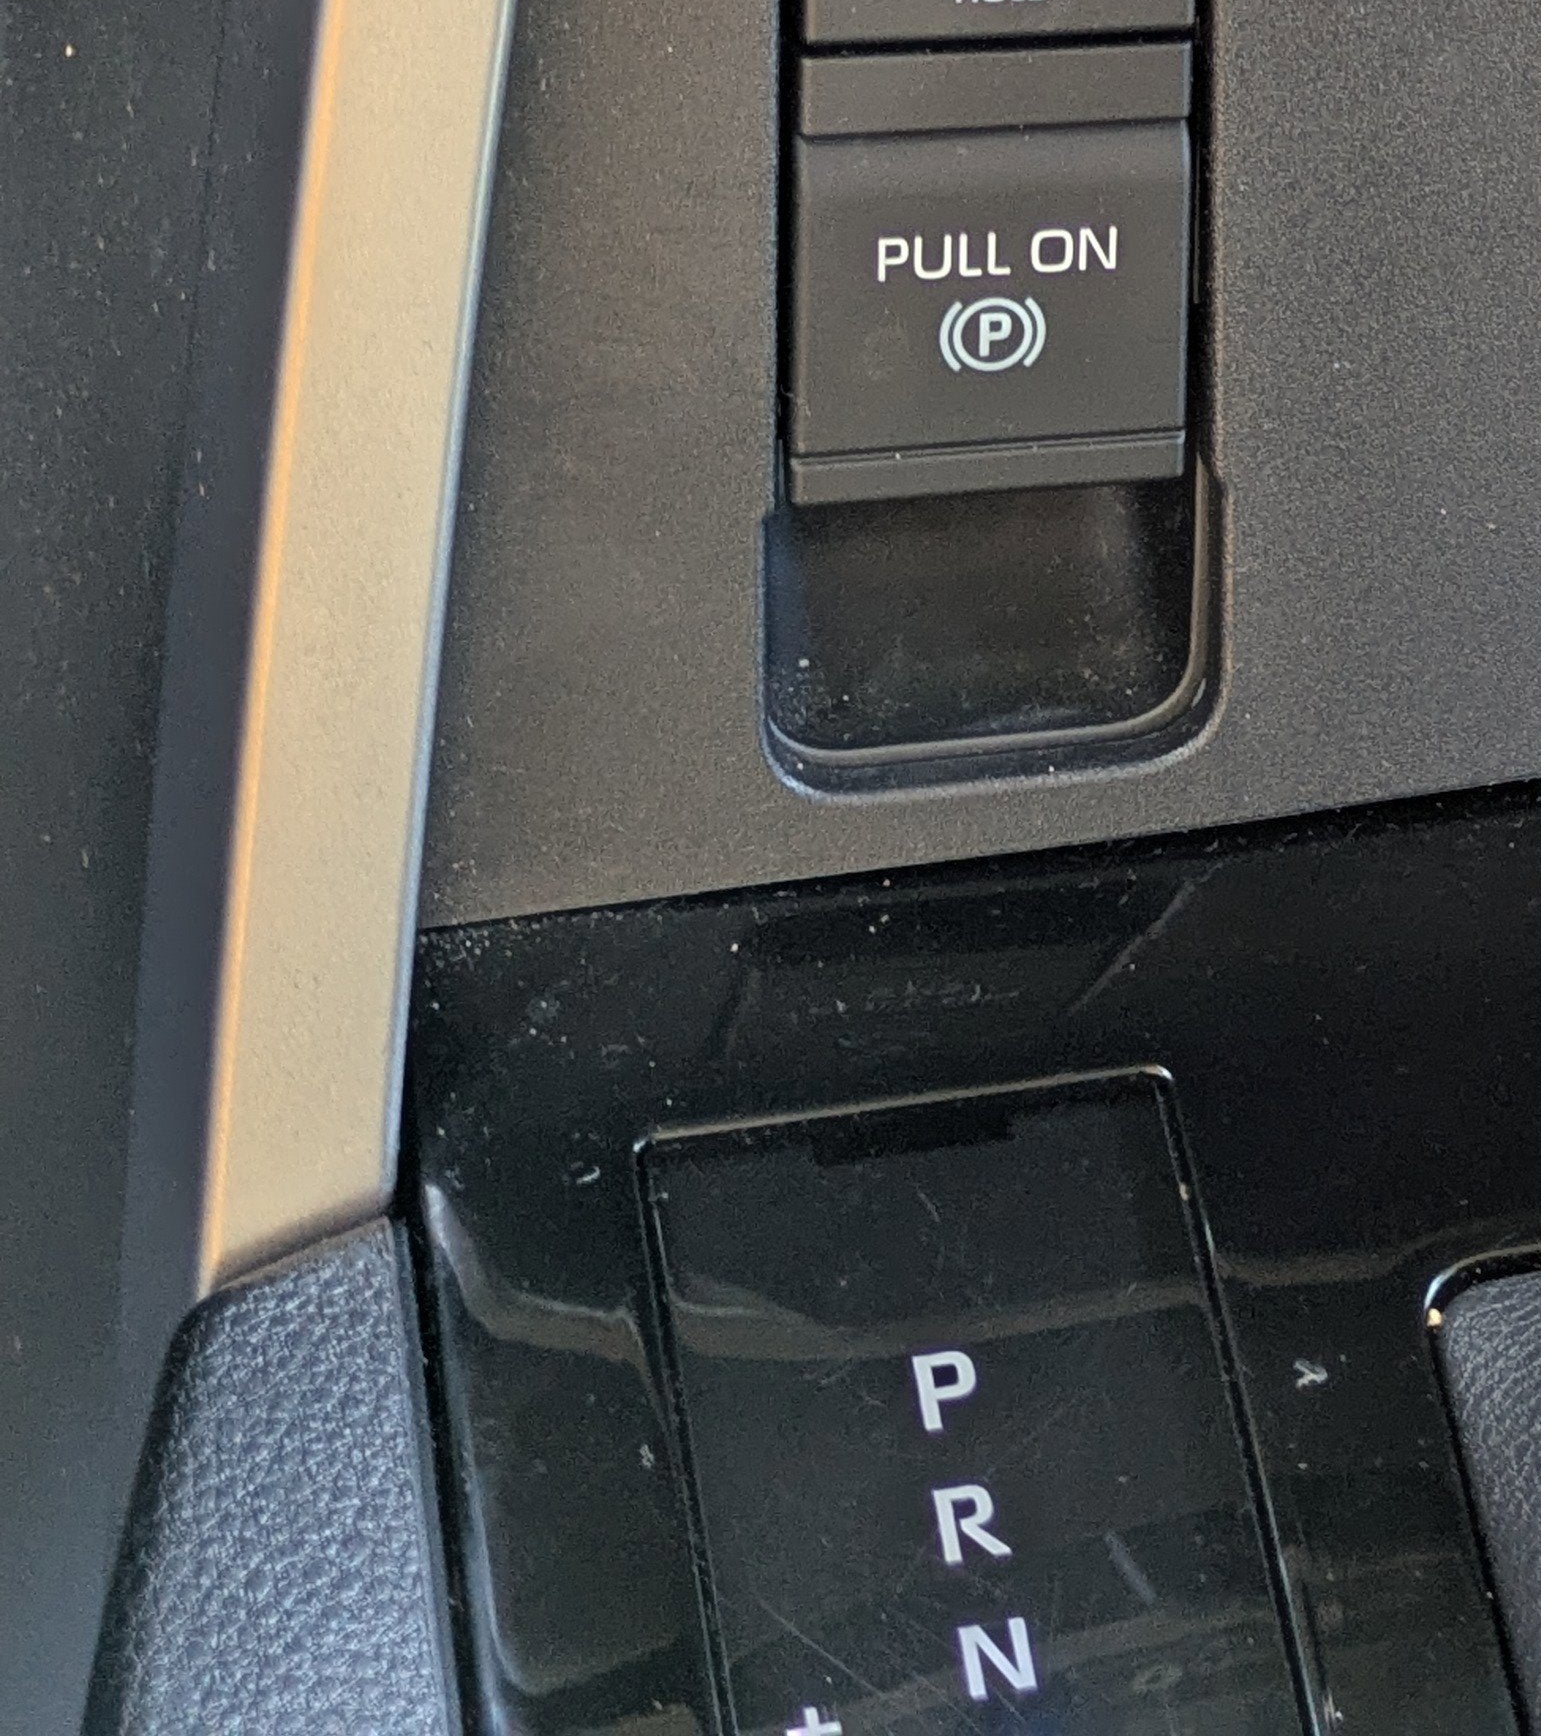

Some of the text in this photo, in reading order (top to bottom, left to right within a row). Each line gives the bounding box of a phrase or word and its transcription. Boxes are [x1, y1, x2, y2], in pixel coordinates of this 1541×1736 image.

[876, 225, 1119, 283] PULL ON
[910, 1350, 977, 1433] P
[932, 1483, 1012, 1565] R
[957, 1616, 1039, 1701] N
